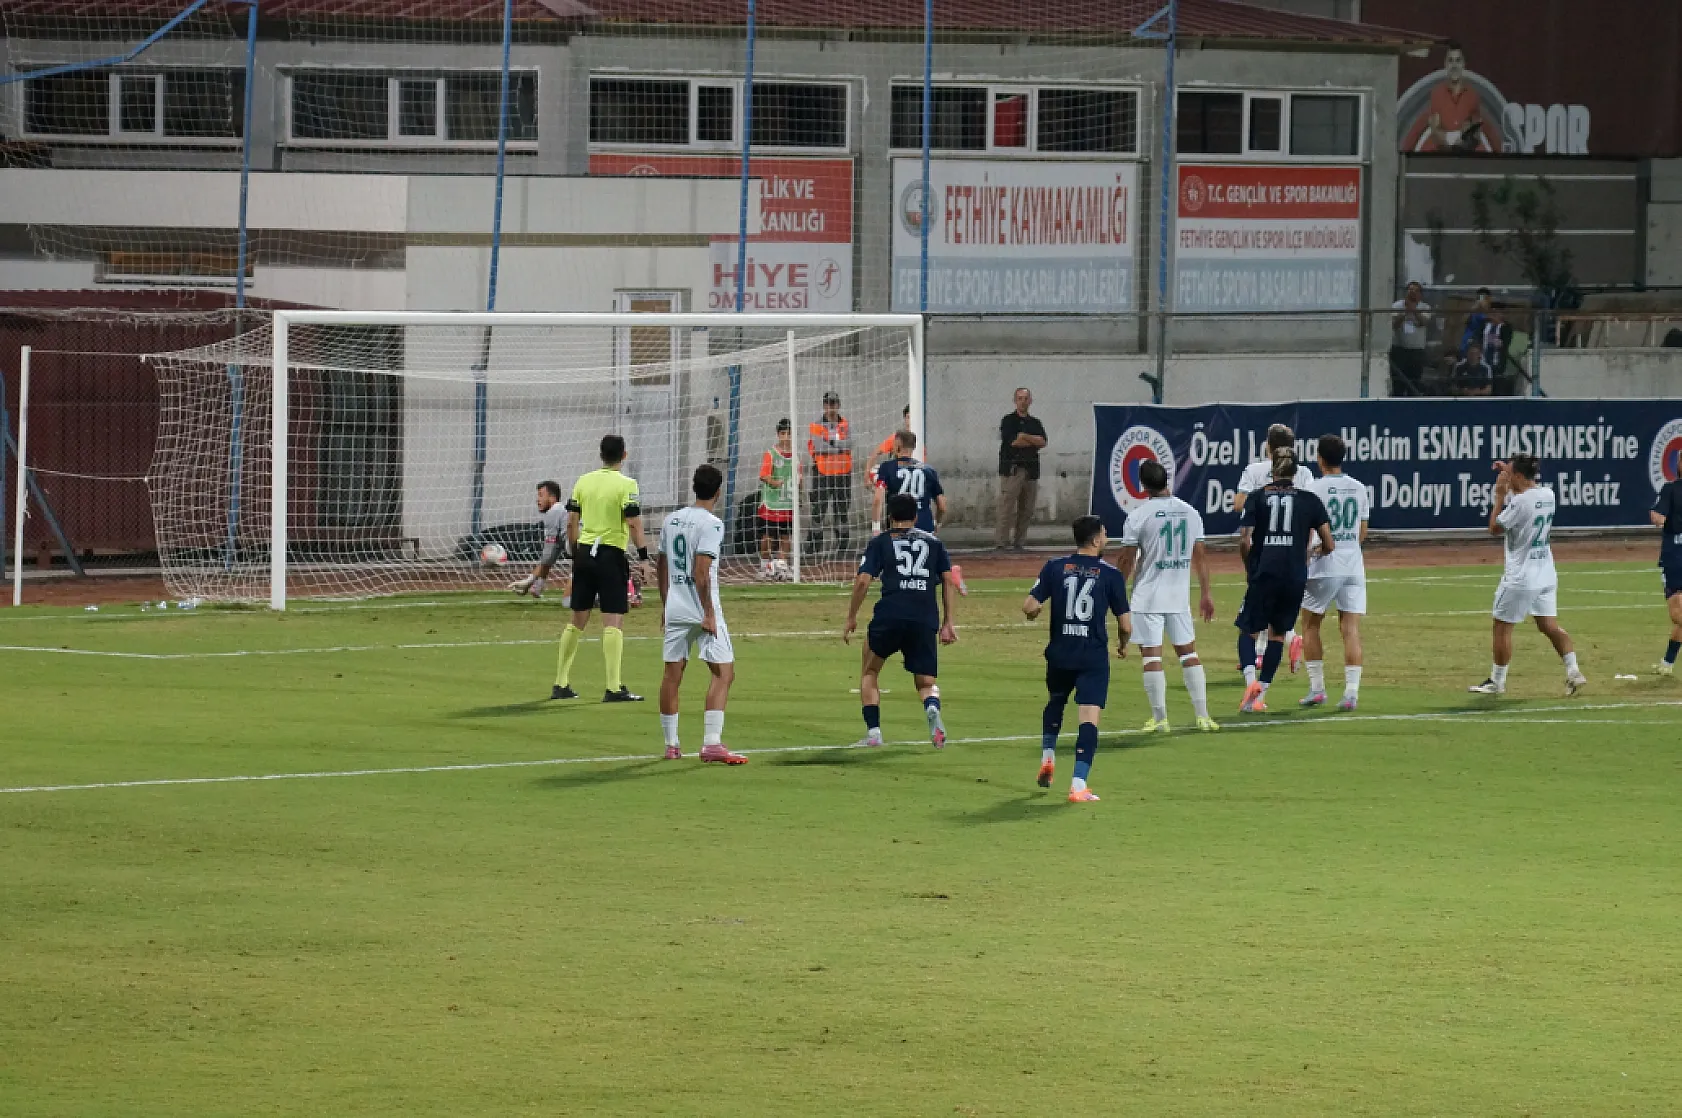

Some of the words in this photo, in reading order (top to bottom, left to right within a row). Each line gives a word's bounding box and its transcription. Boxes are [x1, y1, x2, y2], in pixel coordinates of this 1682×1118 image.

[760, 174, 790, 199] LİK
[793, 179, 816, 199] VE
[1226, 181, 1267, 208] GENÇLİK
[1269, 185, 1282, 204] VE
[1284, 185, 1308, 203] SPOR
[944, 170, 1007, 245] FETHİYE
[1010, 172, 1129, 245] KAYMAKAMLIĞI
[1190, 421, 1240, 466] Özel
[1341, 423, 1411, 462] Hekim
[1418, 425, 1484, 460] ESNAF
[897, 468, 925, 499] 20
[1380, 470, 1452, 516] Dolayı
[1557, 472, 1621, 507] Ederiz
[1266, 495, 1293, 532] 11
[1328, 497, 1358, 532] 30
[673, 533, 687, 572] 9
[1160, 519, 1188, 557] 11
[892, 540, 930, 578] 52
[1063, 576, 1096, 622] 16
